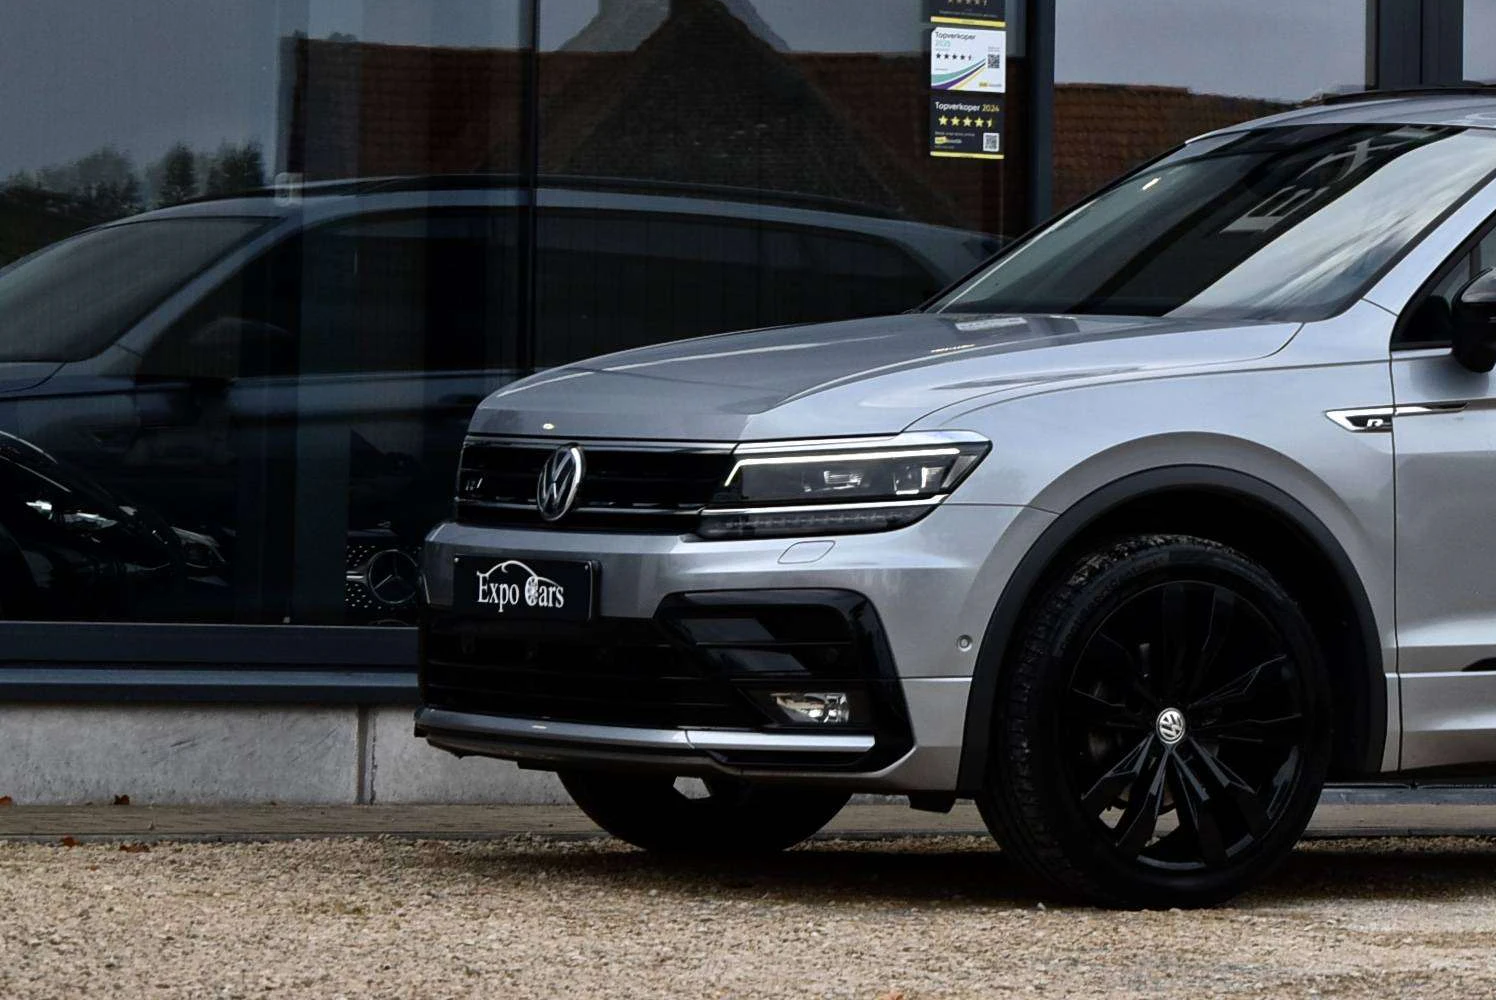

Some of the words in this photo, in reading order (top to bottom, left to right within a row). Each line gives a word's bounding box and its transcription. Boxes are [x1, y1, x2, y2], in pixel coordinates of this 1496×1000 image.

[935, 31, 976, 42] Topverkoper
[935, 101, 980, 113] Topverkoper
[476, 571, 520, 612] Expo
[525, 576, 565, 609] Cars
